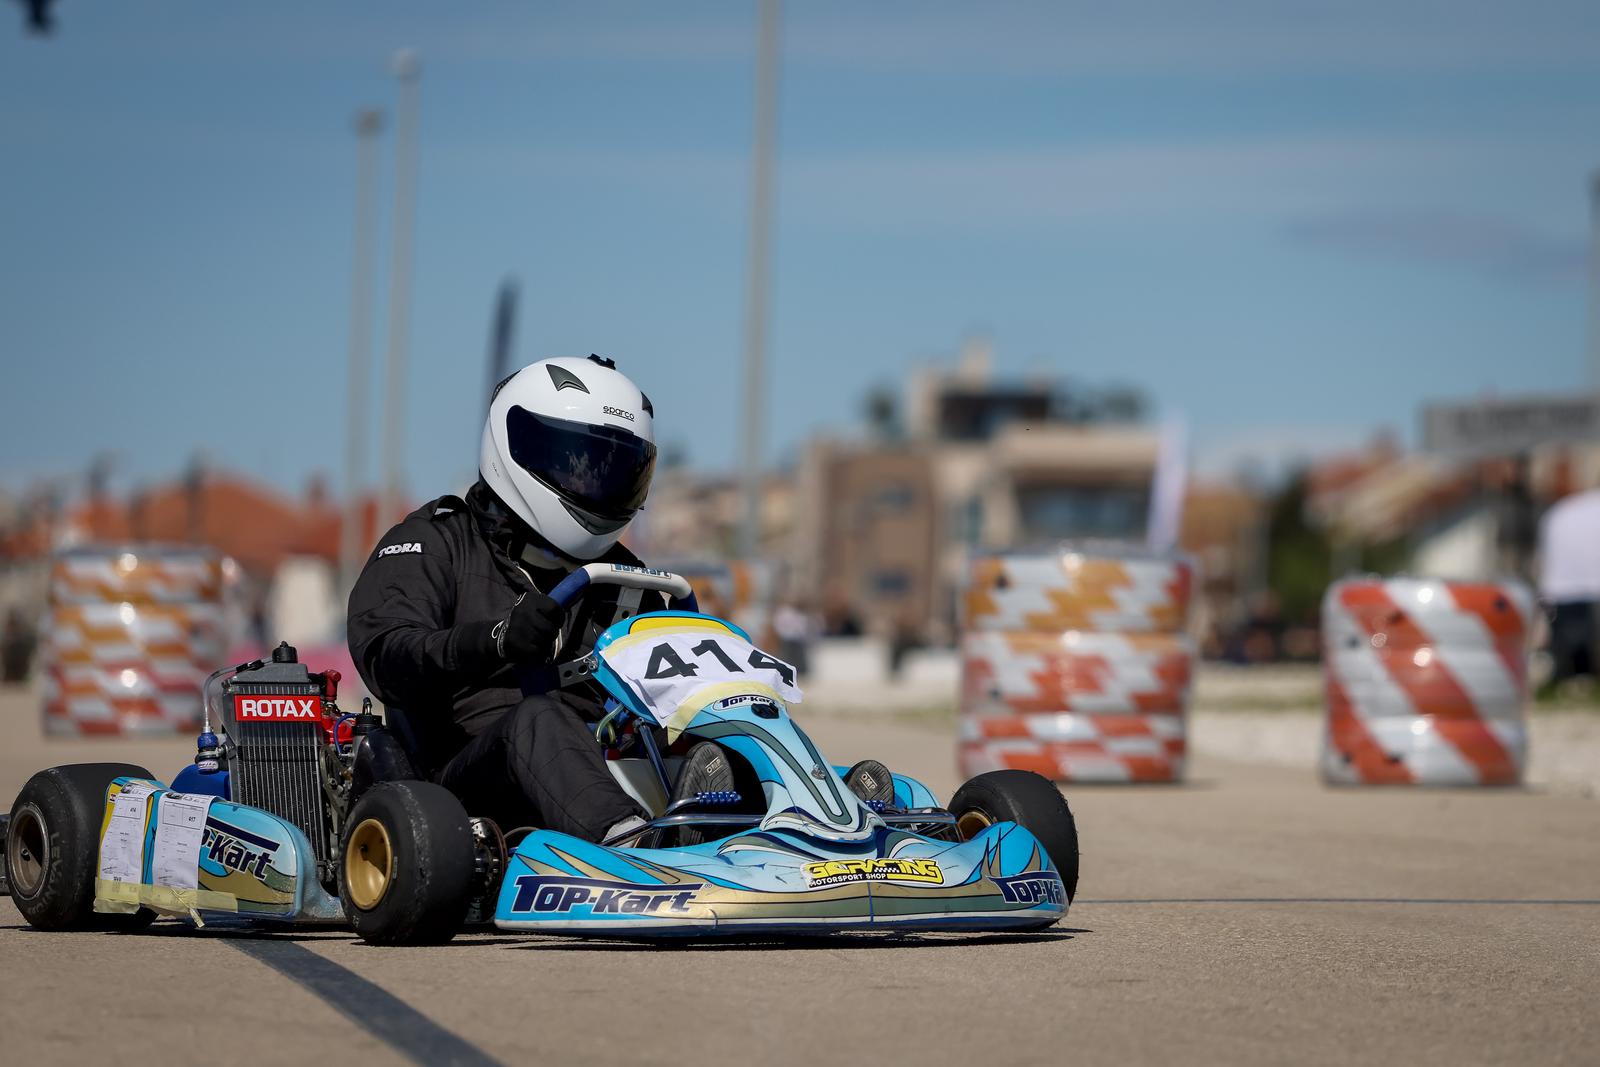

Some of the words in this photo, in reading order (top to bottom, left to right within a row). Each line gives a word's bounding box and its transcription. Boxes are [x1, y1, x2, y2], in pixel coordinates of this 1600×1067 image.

[603, 405, 635, 421] sparco
[644, 639, 794, 688] 414
[241, 700, 315, 718] ROTAX
[706, 758, 721, 775] OMP
[860, 773, 876, 791] OMP
[809, 873, 864, 887] MOTORSPORT
